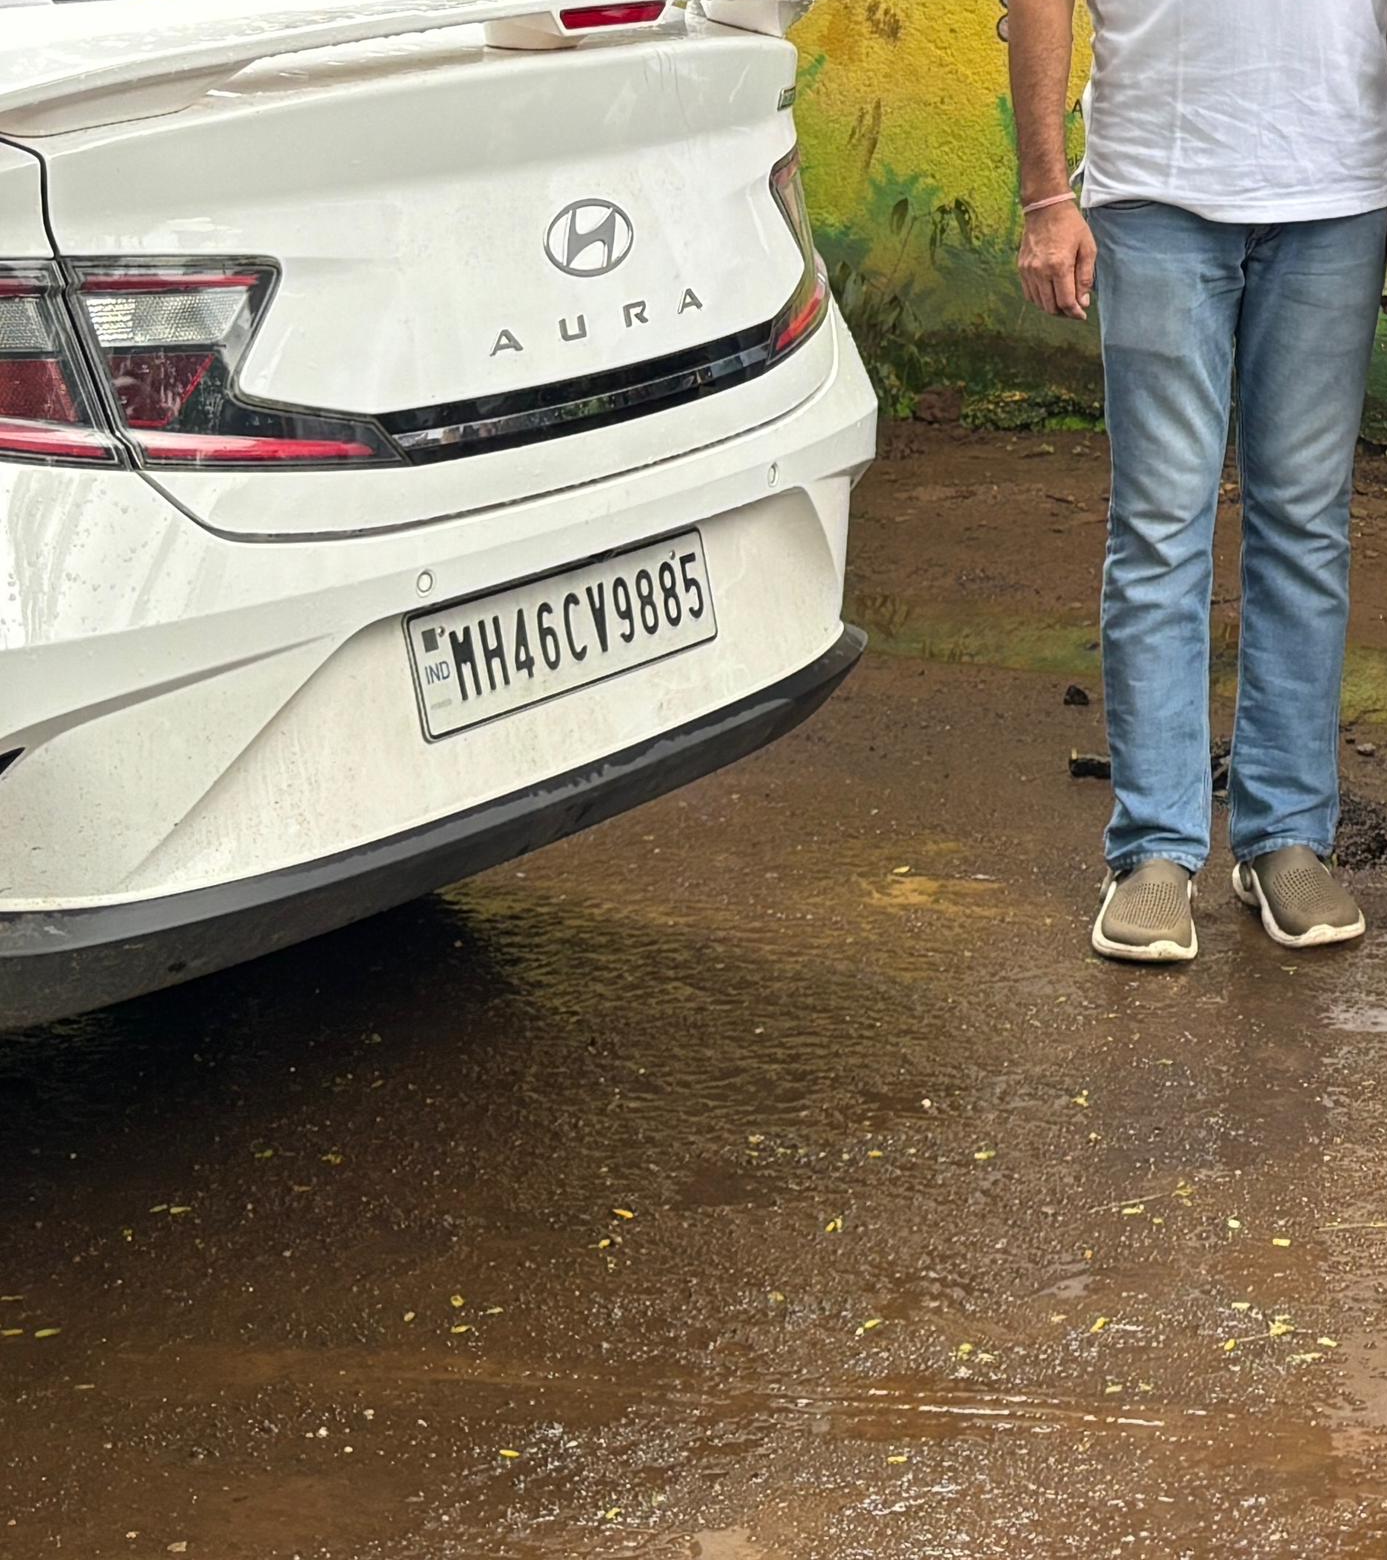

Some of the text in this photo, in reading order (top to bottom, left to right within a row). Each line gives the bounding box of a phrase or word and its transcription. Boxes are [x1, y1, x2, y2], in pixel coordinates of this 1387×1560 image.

[489, 287, 703, 357] AURA
[448, 552, 705, 701] MH46CV9885
[424, 660, 451, 686] IND
